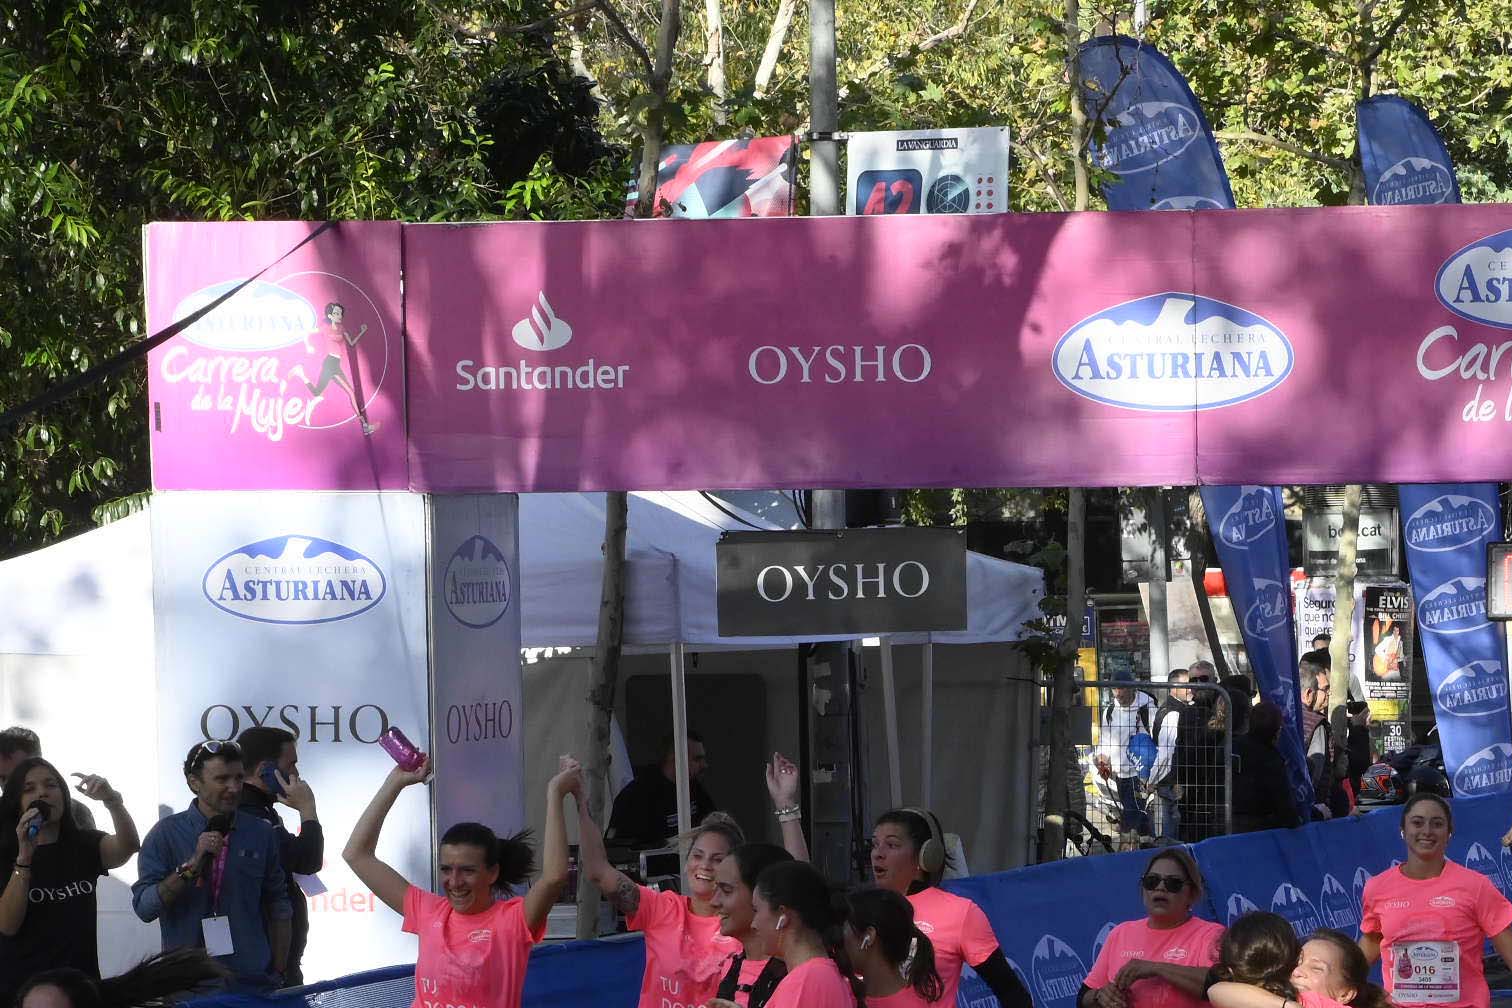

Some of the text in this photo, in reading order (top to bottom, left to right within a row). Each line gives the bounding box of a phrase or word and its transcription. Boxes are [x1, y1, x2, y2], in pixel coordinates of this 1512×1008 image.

[909, 138, 957, 150] VANGUARDIA
[1191, 332, 1266, 345] LECHERA
[160, 346, 281, 384] Carrera
[748, 342, 933, 387] OYSHO
[1072, 337, 1274, 381] ASTURIANA
[456, 359, 630, 392] Santander
[191, 380, 325, 441] de la Mujer
[1461, 383, 1497, 423] de
[218, 568, 373, 602] ASTURIANA
[449, 576, 507, 605] ASTURIANA
[756, 560, 930, 602] OYSHO
[1379, 597, 1409, 608] ELVIS
[1304, 613, 1321, 625] que
[1304, 627, 1334, 639] quiere
[200, 703, 391, 745] OYSHO
[446, 699, 512, 745] OYSHO
[1389, 725, 1401, 736] 30
[28, 880, 94, 905] OYSHO
[660, 975, 679, 995] TU
[1414, 965, 1436, 975] 016
